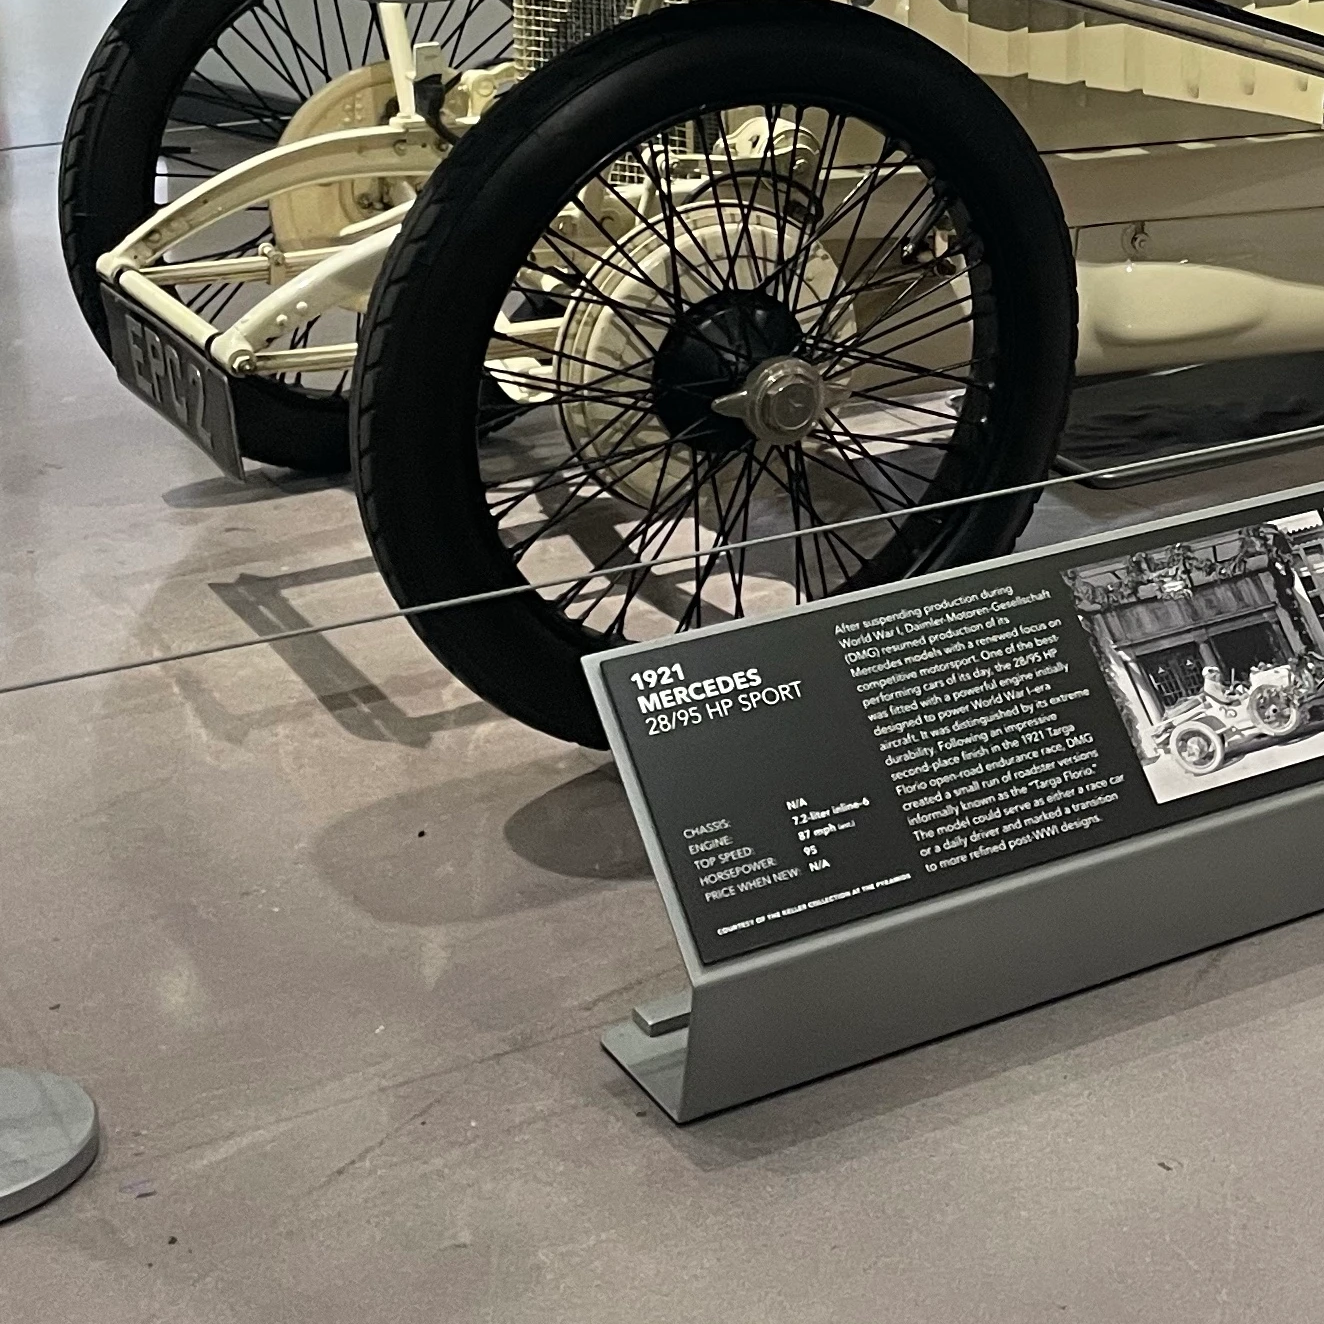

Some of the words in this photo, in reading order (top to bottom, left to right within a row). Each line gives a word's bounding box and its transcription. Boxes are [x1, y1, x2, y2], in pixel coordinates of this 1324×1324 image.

[835, 622, 860, 635] After
[862, 608, 923, 629] suspending
[923, 594, 980, 616] production
[980, 586, 1014, 600] during
[838, 632, 873, 649] World
[871, 629, 895, 641] War
[844, 646, 881, 666] (DMG)
[881, 635, 927, 655] resumed
[927, 623, 985, 646] production
[985, 616, 996, 629] of
[996, 617, 1011, 626] its
[849, 658, 904, 678] Mercedes
[903, 647, 943, 665] models
[943, 641, 966, 655] with
[967, 641, 975, 649] a
[975, 627, 1020, 647] renewed
[1019, 622, 1048, 635] focus
[1047, 618, 1062, 628] on
[630, 662, 686, 691] 1921
[856, 671, 918, 693] competitive
[980, 648, 1004, 661] One
[1004, 642, 1016, 655] of
[1016, 641, 1034, 652] the
[862, 685, 922, 710] performing
[922, 679, 946, 692] cars
[945, 672, 957, 686] of
[957, 672, 972, 682] its
[993, 661, 1012, 673] the
[1012, 651, 1043, 668] 28/95
[1042, 647, 1058, 660] HP
[637, 668, 762, 714] MERCEDES
[645, 706, 703, 736] 28/95
[705, 698, 734, 720] HP
[737, 680, 802, 712] SPORT
[867, 710, 889, 722] was
[889, 699, 919, 716] fitted
[919, 694, 943, 708] with
[943, 693, 952, 702] a
[952, 678, 998, 702] powerful
[998, 672, 1034, 687] engine
[1034, 661, 1069, 678] initially
[873, 714, 924, 737] designed
[923, 714, 937, 723] to
[937, 704, 970, 723] power
[969, 692, 1004, 711] World
[1002, 689, 1025, 702] War
[919, 730, 930, 740] It
[929, 725, 952, 738] was
[951, 704, 1021, 732] distinguished
[1019, 703, 1034, 715] by
[1035, 699, 1049, 709] its
[1049, 688, 1090, 705] extreme
[937, 732, 990, 752] Following
[990, 728, 1004, 738] an
[1003, 713, 1058, 733] impressive
[960, 745, 990, 761] finish
[990, 744, 1002, 754] in
[1001, 739, 1020, 751] the
[1020, 730, 1045, 745] 1921
[1045, 724, 1076, 737] Targa
[895, 781, 928, 796] Florio
[928, 762, 985, 788] open-road
[985, 750, 1040, 772] endurance
[1065, 732, 1094, 749] DMG
[902, 790, 944, 812] created
[944, 791, 952, 800] a
[952, 780, 981, 797] small
[981, 777, 1001, 789] run
[1001, 770, 1013, 784] of
[1013, 761, 1056, 780] roadster
[1056, 749, 1099, 767] versions
[786, 797, 808, 811] N/A
[907, 804, 960, 826] informally
[959, 795, 997, 811] known
[997, 791, 1010, 801] as
[1009, 785, 1028, 797] the
[912, 829, 935, 842] The
[936, 816, 971, 835] model
[972, 807, 1002, 825] could
[1002, 801, 1032, 816] serve
[1033, 797, 1046, 808] as
[1046, 788, 1075, 804] either
[1077, 786, 1085, 795] a
[1085, 779, 1108, 792] race
[1109, 774, 1124, 785] car
[919, 847, 932, 857] or
[934, 844, 942, 853] a
[942, 835, 968, 851] daily
[969, 827, 1000, 843] driver
[1002, 818, 1023, 833] and
[1023, 806, 1063, 827] marked
[1064, 806, 1072, 815] a
[1071, 792, 1119, 813] transition
[797, 829, 811, 841] 87
[803, 844, 818, 856] 95
[924, 863, 938, 873] to
[939, 854, 968, 869] more
[968, 839, 1007, 860] refined
[693, 856, 717, 870] TOP
[808, 858, 831, 872] N/A
[704, 885, 736, 902] PRICE
[736, 875, 772, 893] WHEN
